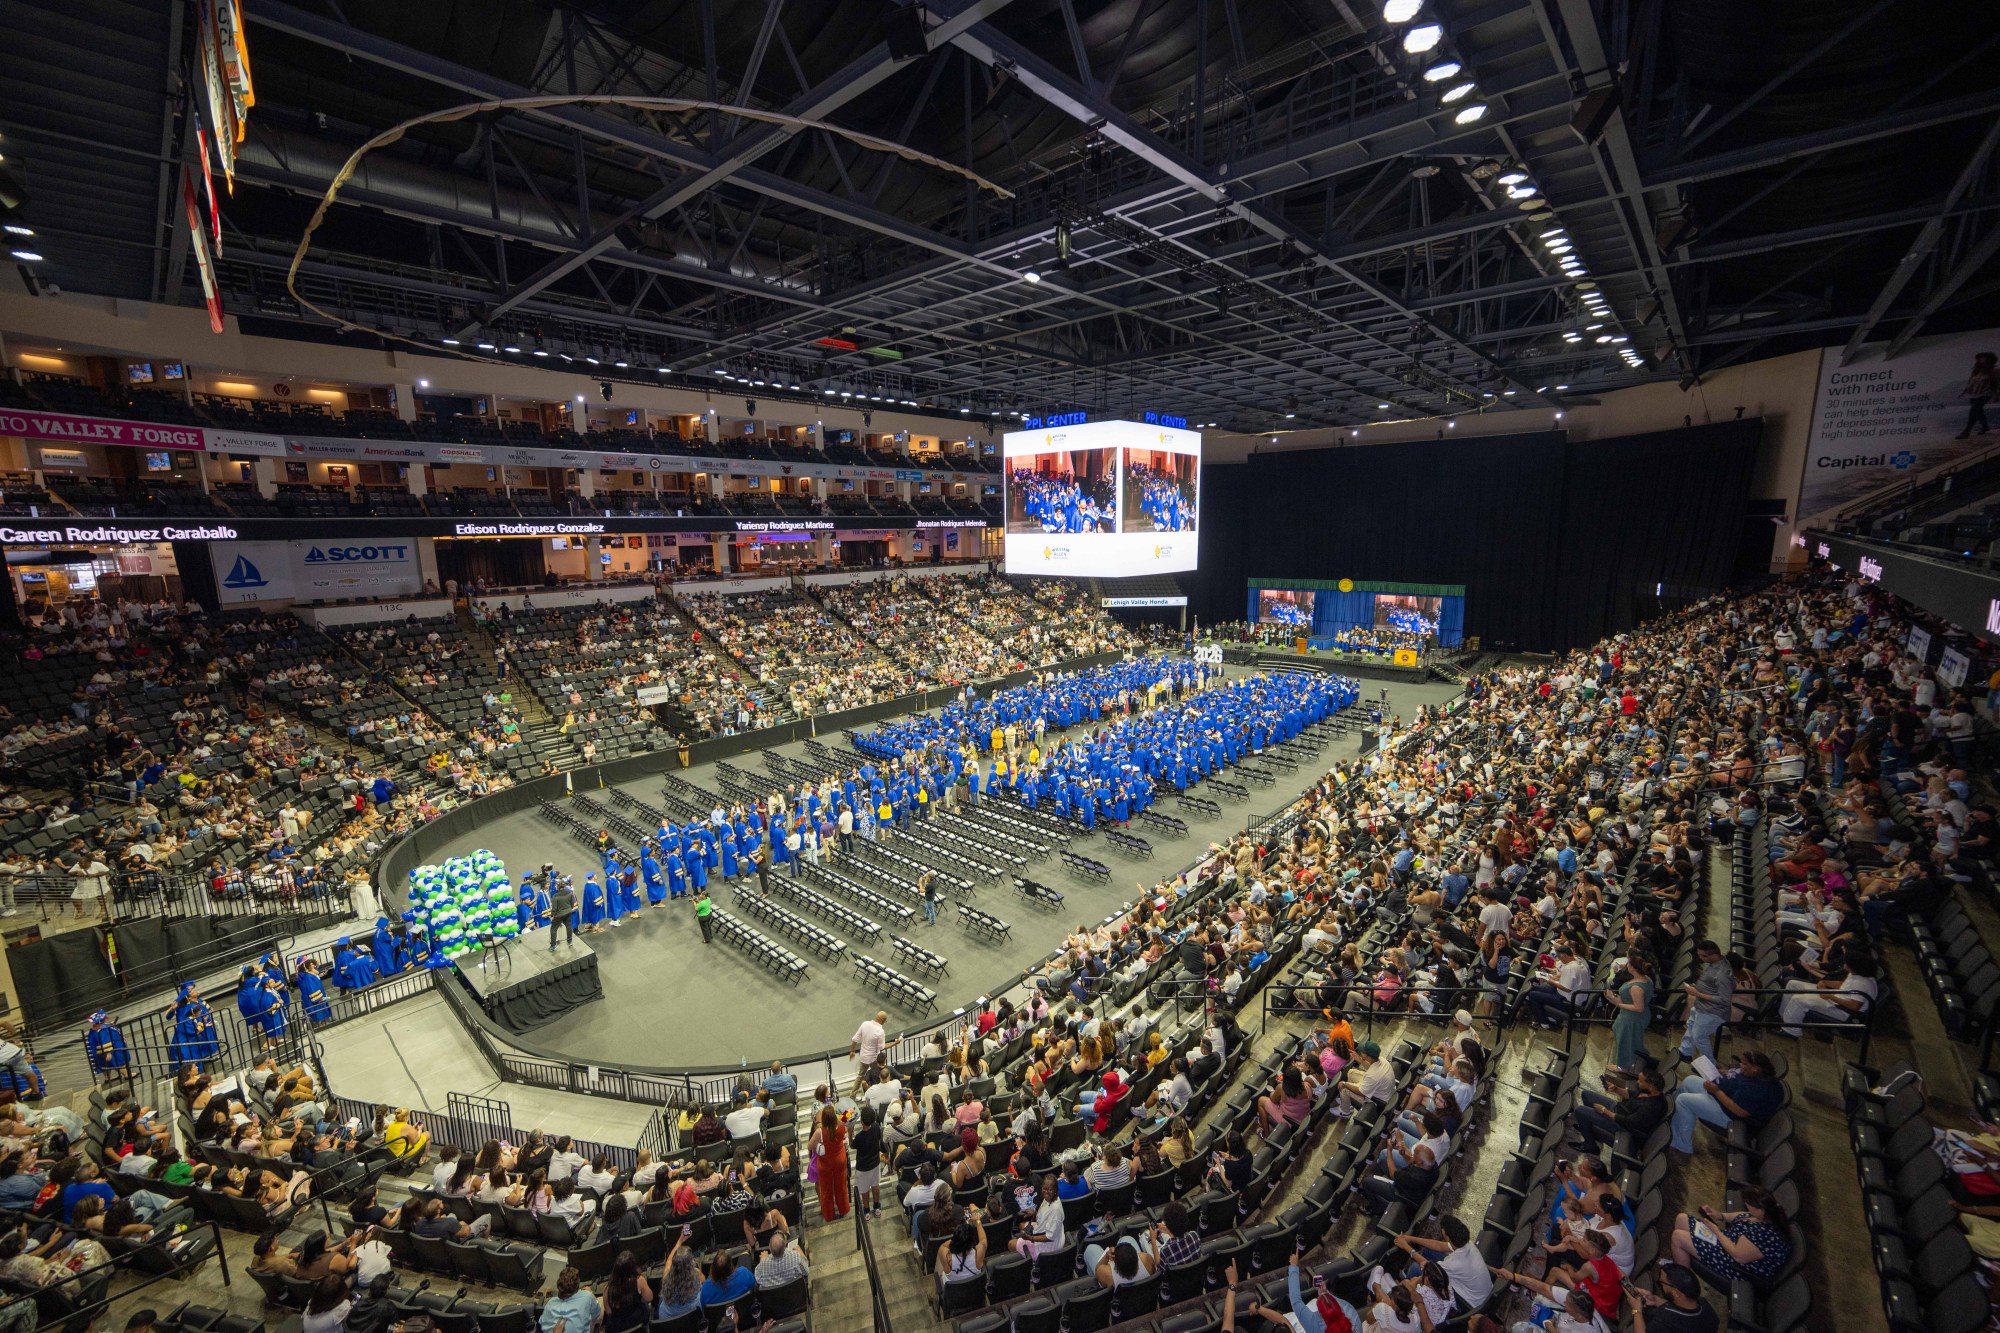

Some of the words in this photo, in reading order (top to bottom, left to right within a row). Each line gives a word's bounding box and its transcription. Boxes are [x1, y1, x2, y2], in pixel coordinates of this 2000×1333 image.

[1831, 369, 1894, 384] Connect
[1828, 384, 1861, 396] with
[1866, 381, 1917, 393] nature
[1826, 399, 1840, 409] 30
[1843, 396, 1885, 407] minutes
[1900, 392, 1931, 403] week
[1824, 410, 1843, 419] can
[1846, 407, 1869, 418] help
[1872, 404, 1923, 416] decrease
[1926, 402, 1947, 412] risk
[1025, 417, 1044, 430] PPL
[1046, 412, 1087, 427] CENTER
[1145, 412, 1159, 425] PPL
[1160, 414, 1187, 429] CENTER
[1822, 420, 1834, 429] of
[1836, 416, 1895, 429] depression
[1898, 415, 1919, 424] and
[0, 416, 28, 433] TO
[31, 418, 123, 440] VALLEY
[131, 427, 199, 446] FORGE
[1821, 429, 1843, 440] high
[1846, 428, 1876, 438] blood
[1879, 426, 1928, 437] pressure
[225, 438, 254, 446] VALLEY
[255, 440, 278, 448] FORGE
[364, 447, 425, 457] AmericanBank
[1817, 454, 1886, 470] Capital
[456, 524, 497, 534] Edison
[499, 523, 556, 535] Rodriguez
[557, 523, 605, 533] Gonzalez
[736, 522, 769, 531] Yariensy
[769, 521, 804, 531] Rodriguez
[805, 521, 834, 529] Martinez
[916, 520, 940, 528] Jhonatan
[941, 520, 965, 528] Rodriguez
[0, 527, 62, 543] Caren
[66, 526, 161, 544] Rodriguez
[163, 526, 238, 540] Caraballo
[328, 545, 408, 562] SCOTT
[241, 593, 258, 601] 113
[566, 591, 585, 599] 114C
[379, 604, 404, 613] 113C
[1193, 644, 1223, 663] 2026
